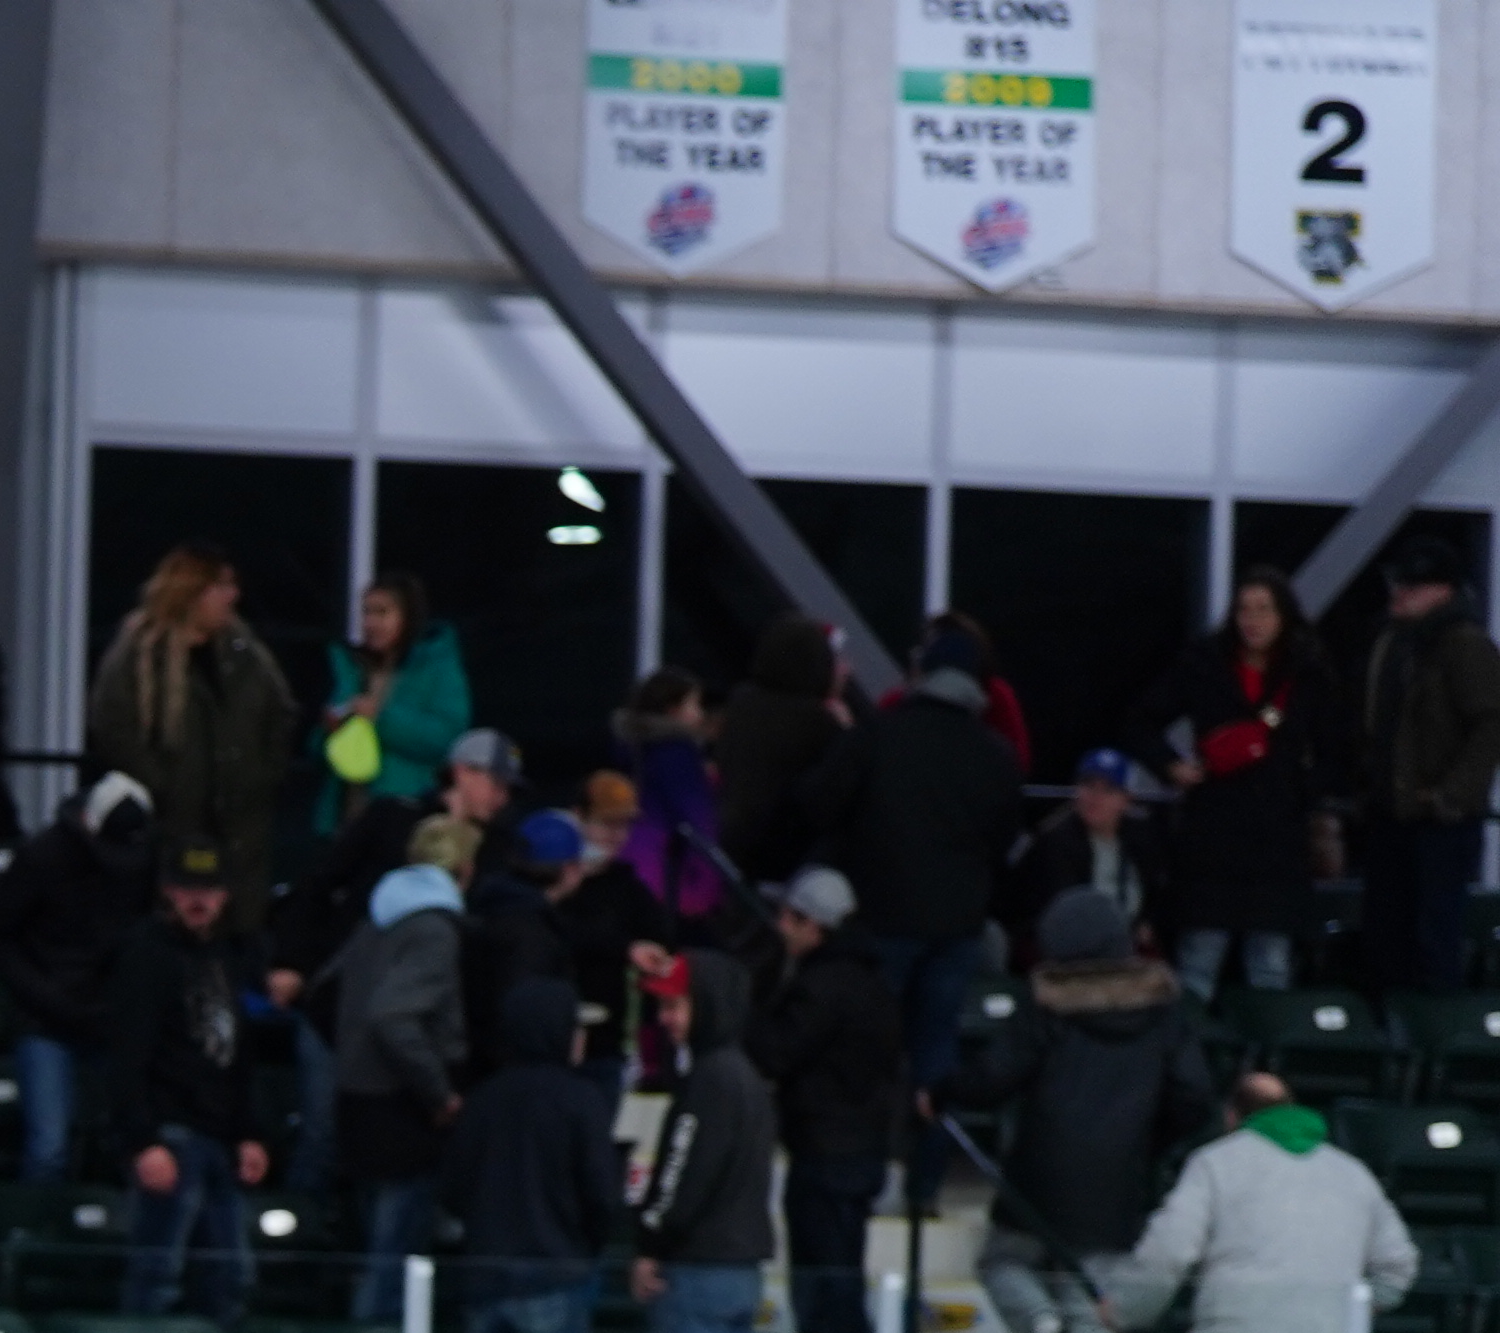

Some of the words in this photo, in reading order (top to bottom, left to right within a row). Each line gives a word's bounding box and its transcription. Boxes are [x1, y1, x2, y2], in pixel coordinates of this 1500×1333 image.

[606, 103, 717, 134] PLAYER
[733, 108, 771, 136] OF
[914, 115, 1026, 145] PLAYER
[1040, 121, 1077, 147] OF
[616, 139, 668, 169] THE
[686, 145, 766, 172] YEAR
[1301, 100, 1366, 182] 2
[922, 151, 974, 180] THE
[992, 156, 1071, 183] YEAR
